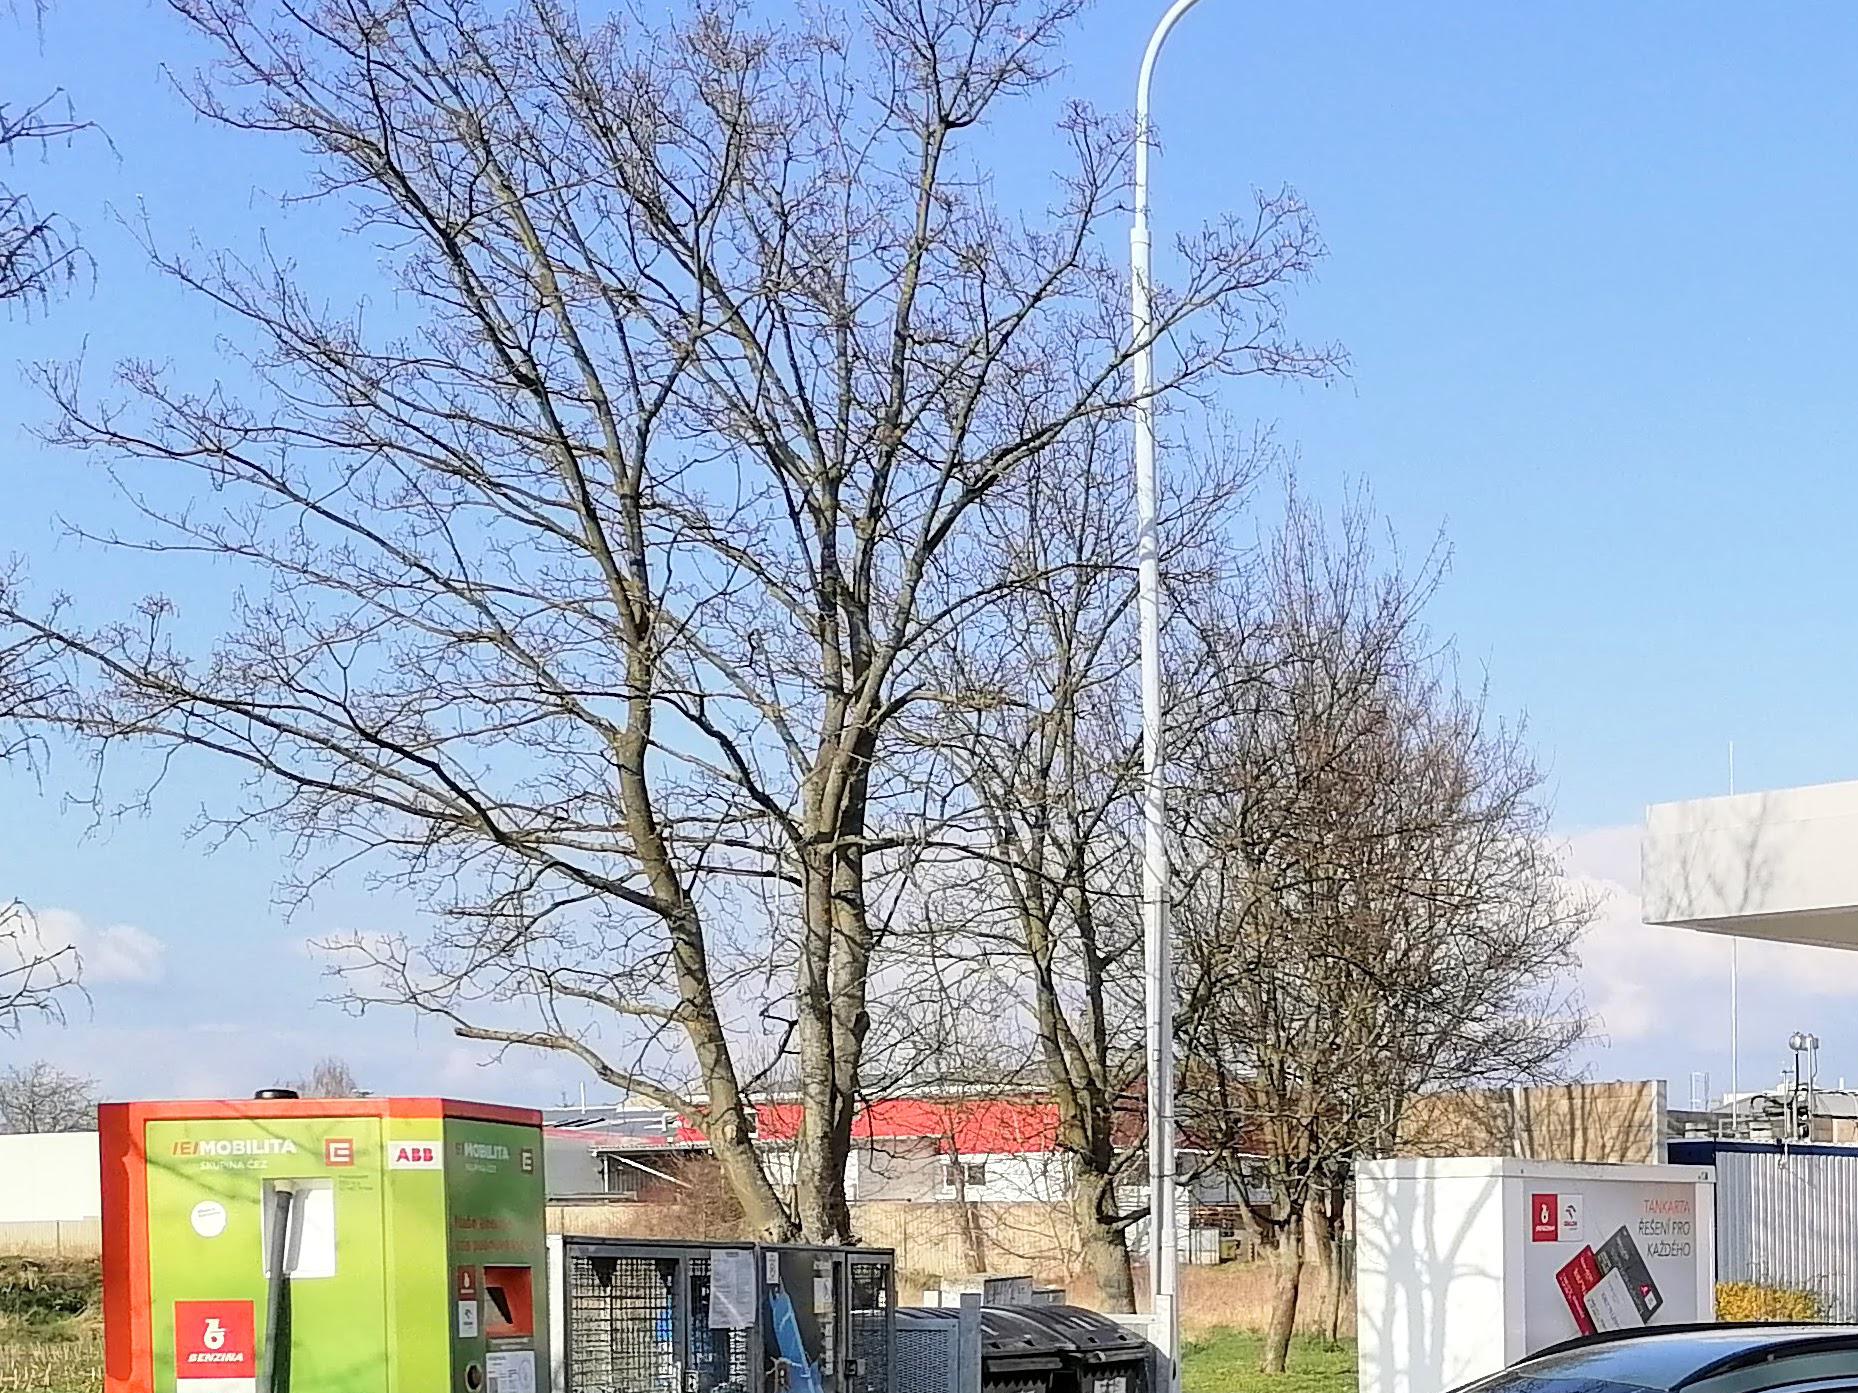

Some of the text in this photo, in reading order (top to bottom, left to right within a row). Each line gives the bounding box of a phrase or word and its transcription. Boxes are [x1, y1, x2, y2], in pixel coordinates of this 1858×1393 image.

[396, 1147, 434, 1162] ABB
[1643, 1200, 1690, 1214] TANKARTA
[1638, 1217, 1690, 1235] ŘEŠENÍ PRO
[1646, 1239, 1691, 1257] KAŽDÉHO
[187, 1352, 244, 1363] BENZINA
